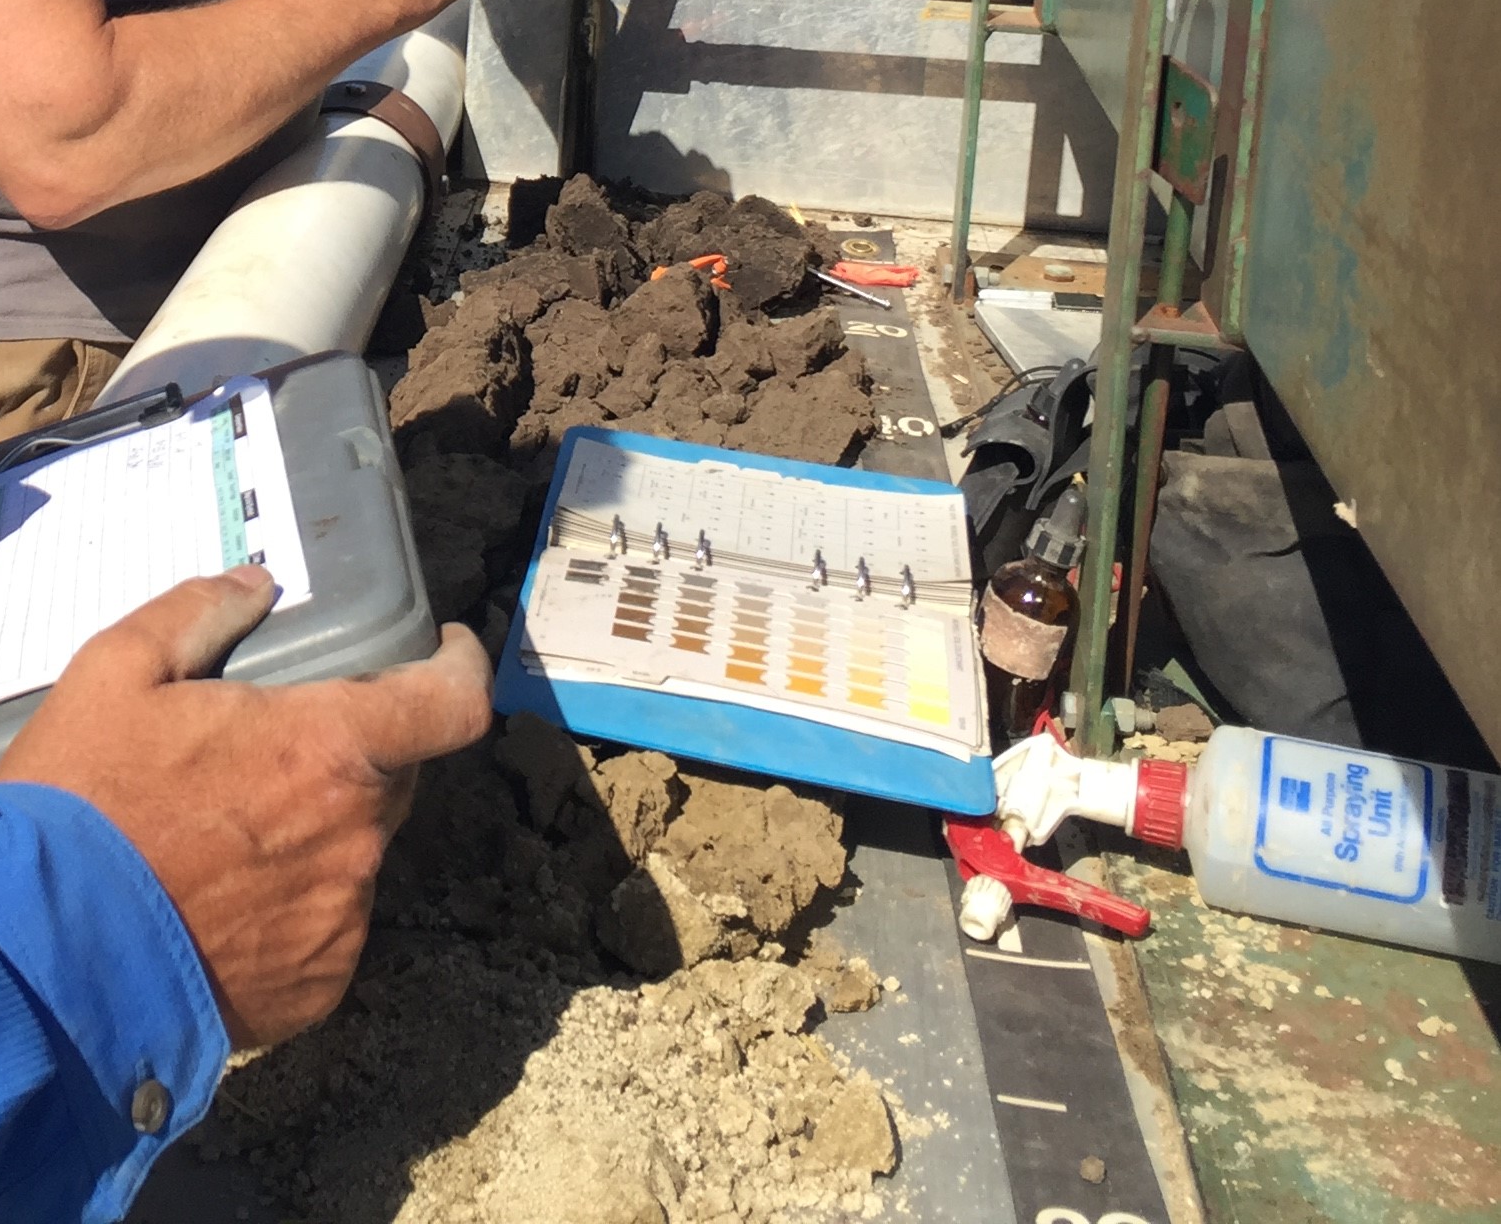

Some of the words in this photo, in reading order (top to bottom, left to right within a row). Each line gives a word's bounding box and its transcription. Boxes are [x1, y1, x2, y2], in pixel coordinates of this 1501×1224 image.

[843, 321, 908, 338] 20
[1334, 763, 1369, 862] Spraying
[1368, 788, 1392, 837] Unit
